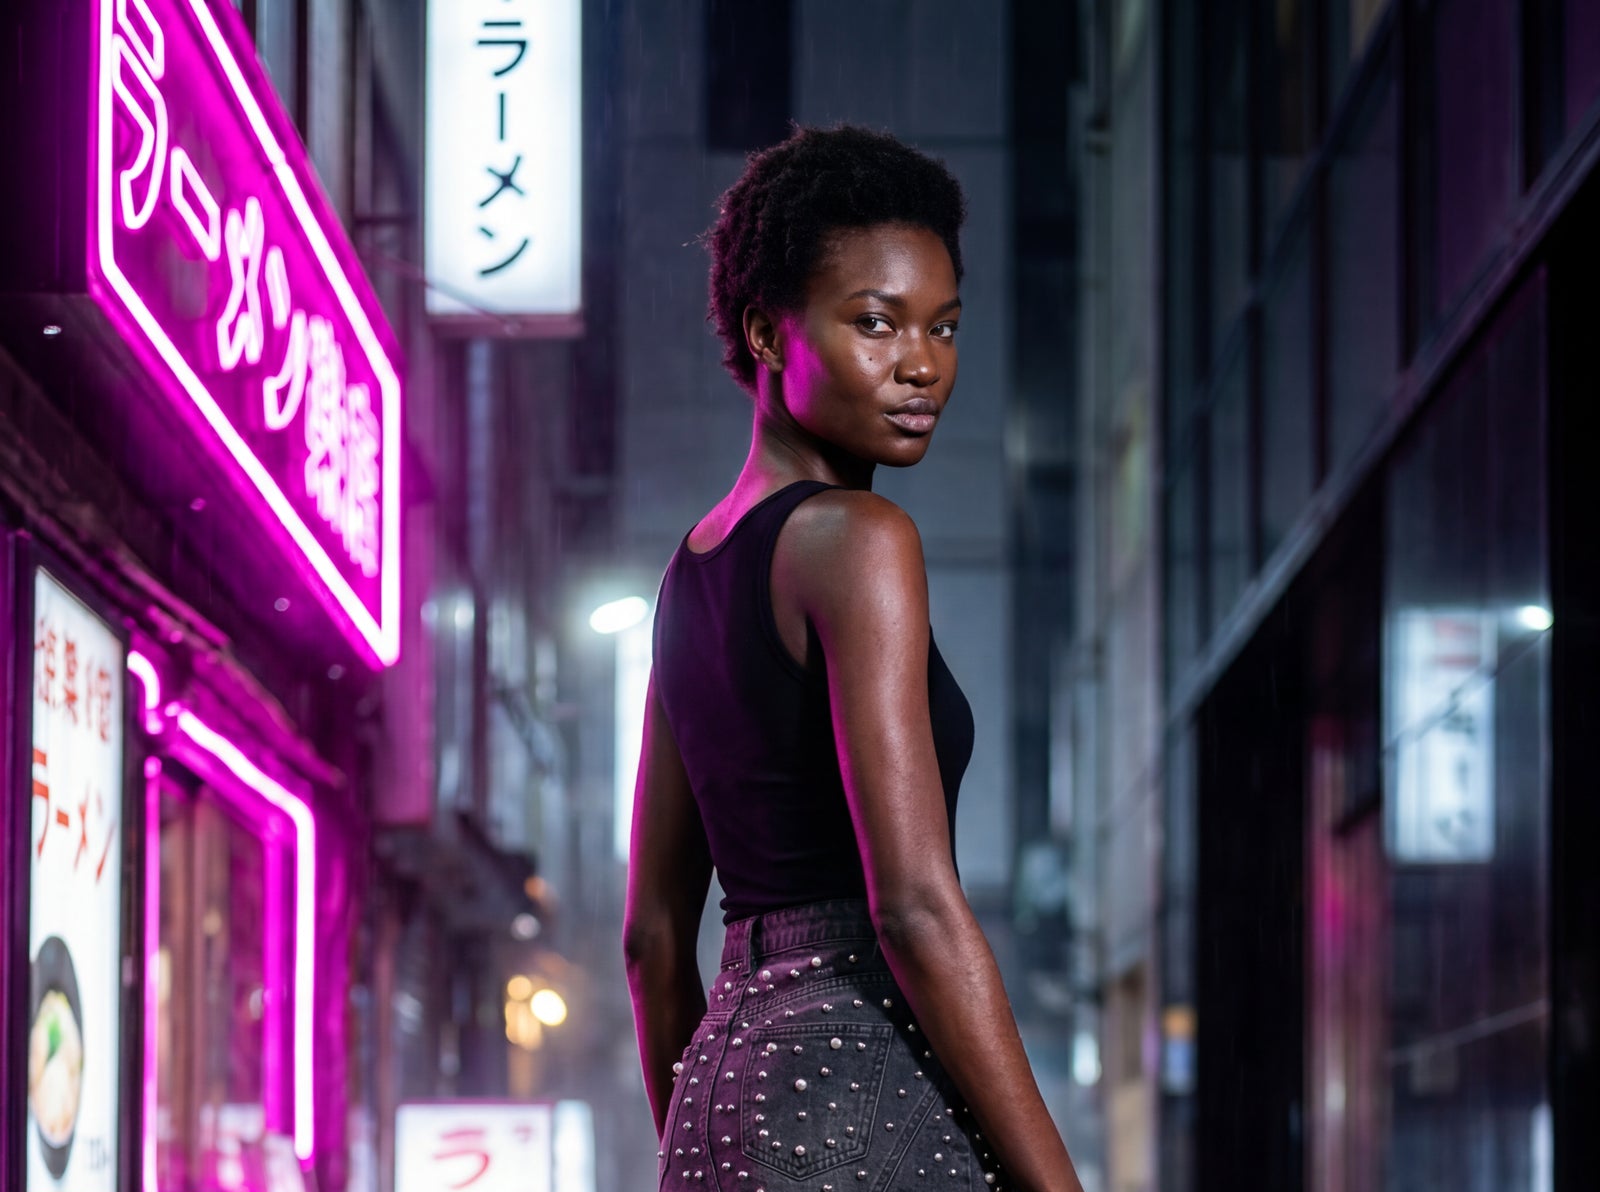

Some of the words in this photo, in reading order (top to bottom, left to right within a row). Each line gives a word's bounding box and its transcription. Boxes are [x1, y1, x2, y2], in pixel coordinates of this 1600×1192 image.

[476, 20, 529, 276] ラーメン
[33, 747, 116, 882] ラーメン
